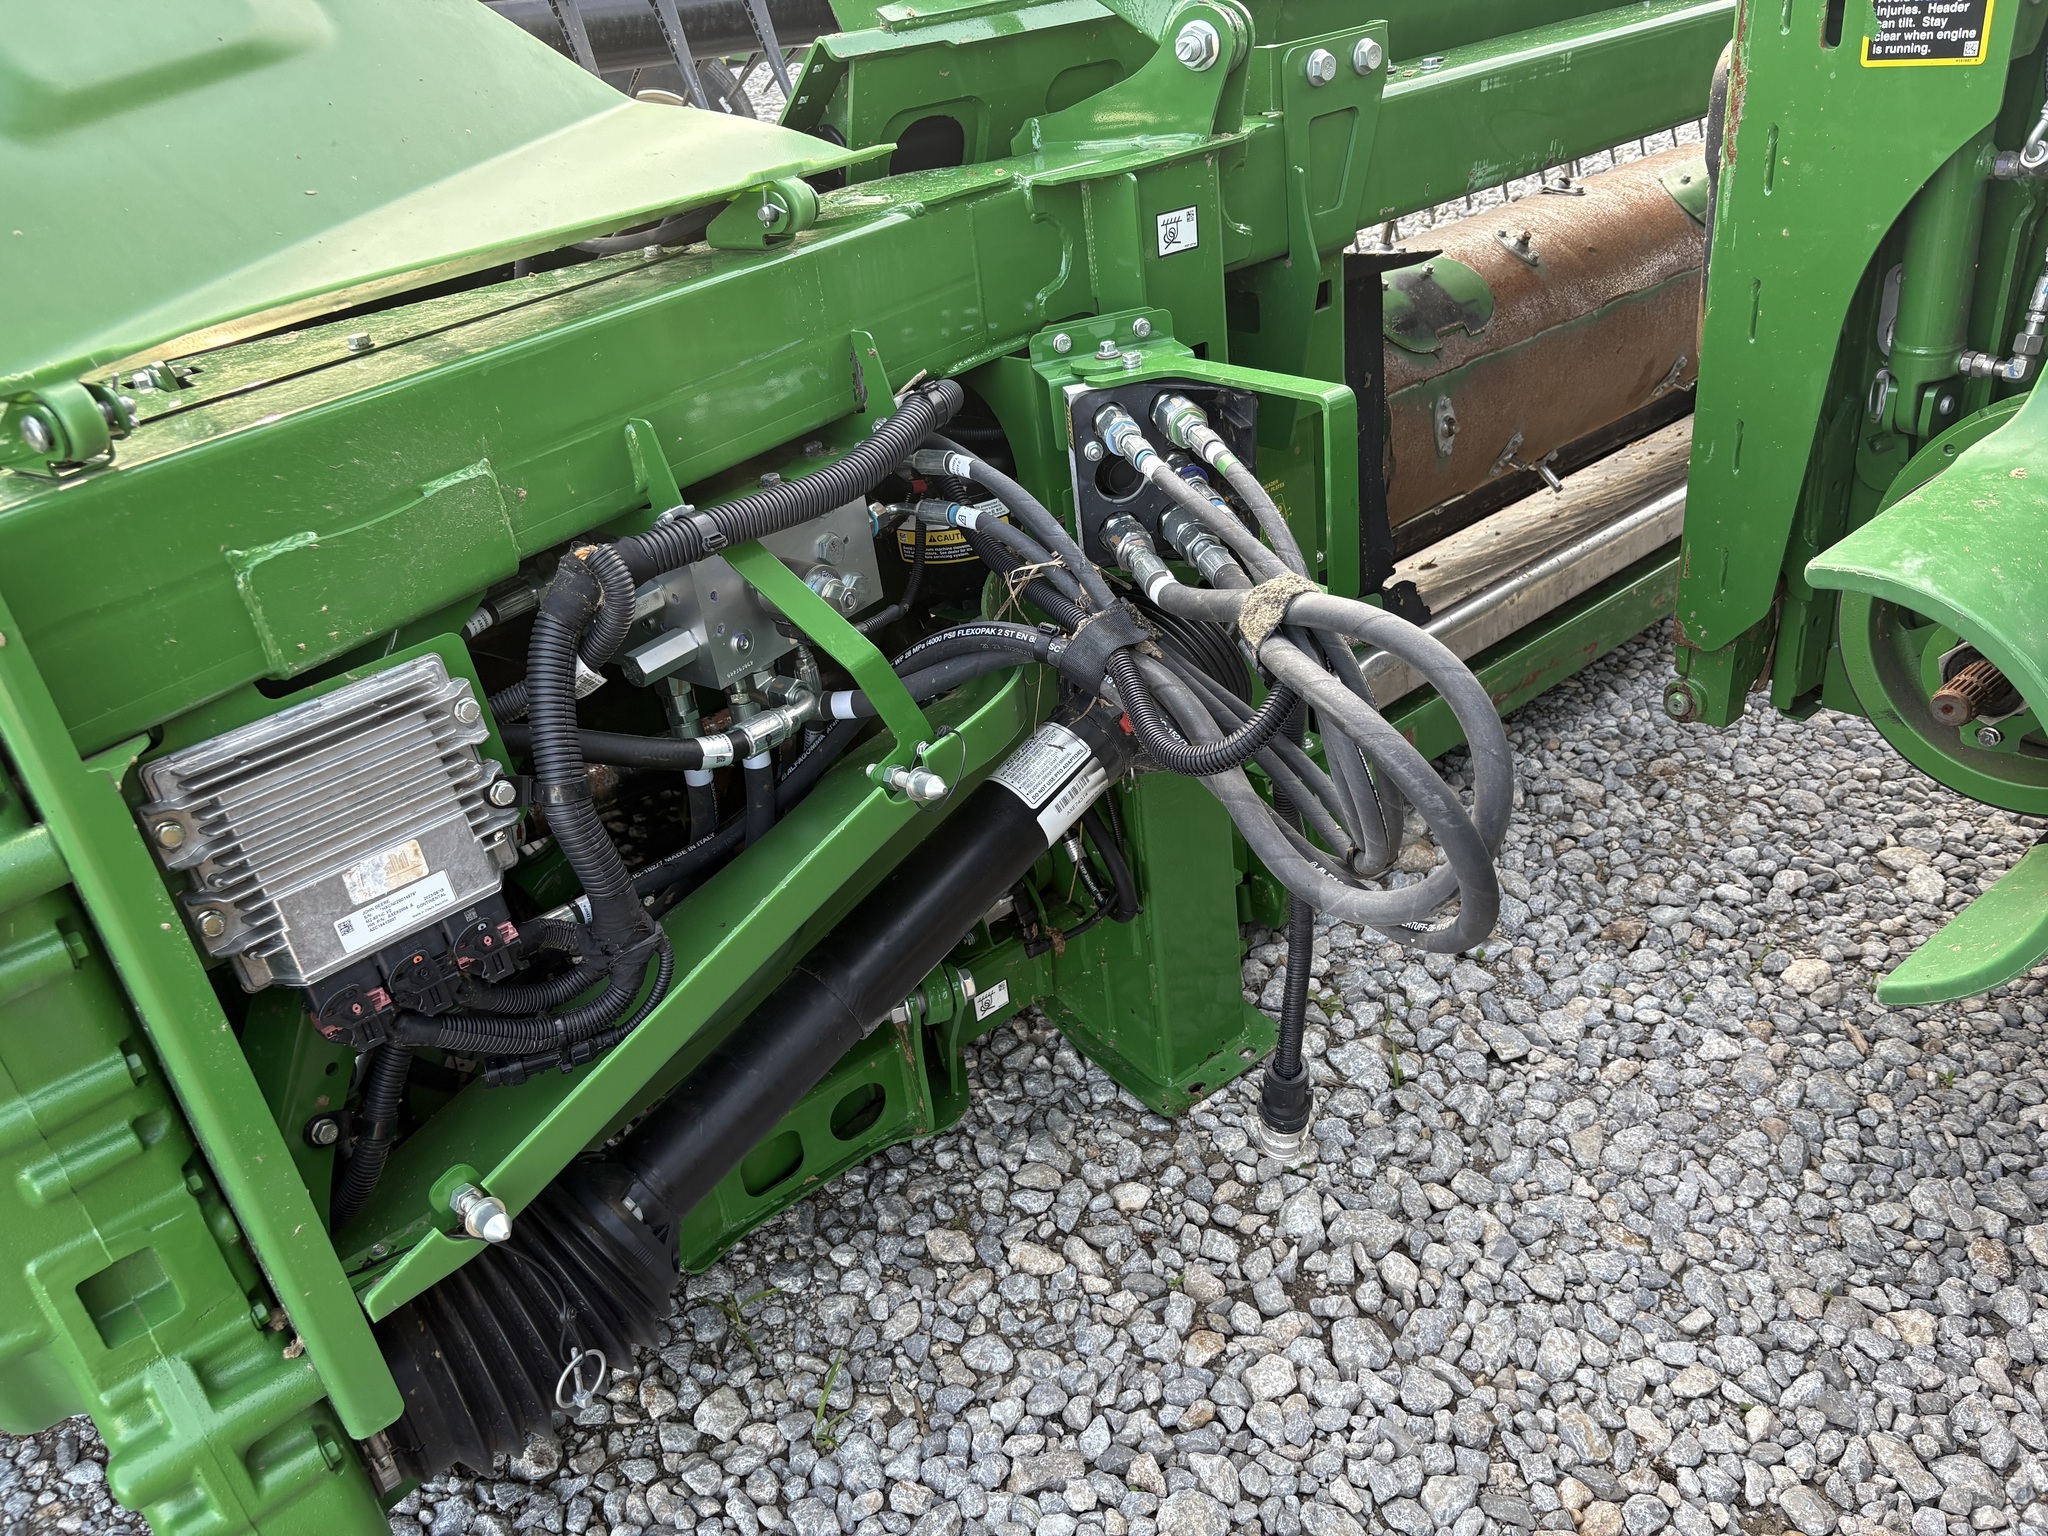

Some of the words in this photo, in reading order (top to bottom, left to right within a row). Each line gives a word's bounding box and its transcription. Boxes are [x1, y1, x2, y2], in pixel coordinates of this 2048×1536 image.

[1877, 5, 1921, 17] injuries.
[1928, 2, 1970, 14] Header
[1898, 16, 1916, 28] tilt.
[1922, 16, 1948, 29] Stay
[1875, 29, 1900, 42] clear
[1903, 30, 1933, 41] when
[1936, 28, 1976, 42] engine
[1872, 44, 1882, 54] is
[1885, 43, 1931, 55] running.
[895, 654, 905, 666] WP
[912, 642, 926, 653] MPa
[957, 628, 997, 637] FLEXOPAK
[1004, 629, 1015, 638] ST
[1015, 632, 1028, 640] EN
[786, 734, 826, 776] ALFAGOMMA
[1006, 752, 1021, 766] KEEP
[1032, 792, 1040, 800] DO
[1038, 784, 1047, 794] NOT
[1046, 776, 1056, 786] USE
[1054, 768, 1064, 778] PTO
[1062, 749, 1084, 770] ADAPTORS
[664, 846, 687, 863] MADE
[687, 843, 697, 854] IN
[695, 832, 716, 849] ITALY
[362, 907, 374, 915] JOHN
[375, 900, 390, 909] DEERE
[417, 892, 446, 909] CONTINENTAL
